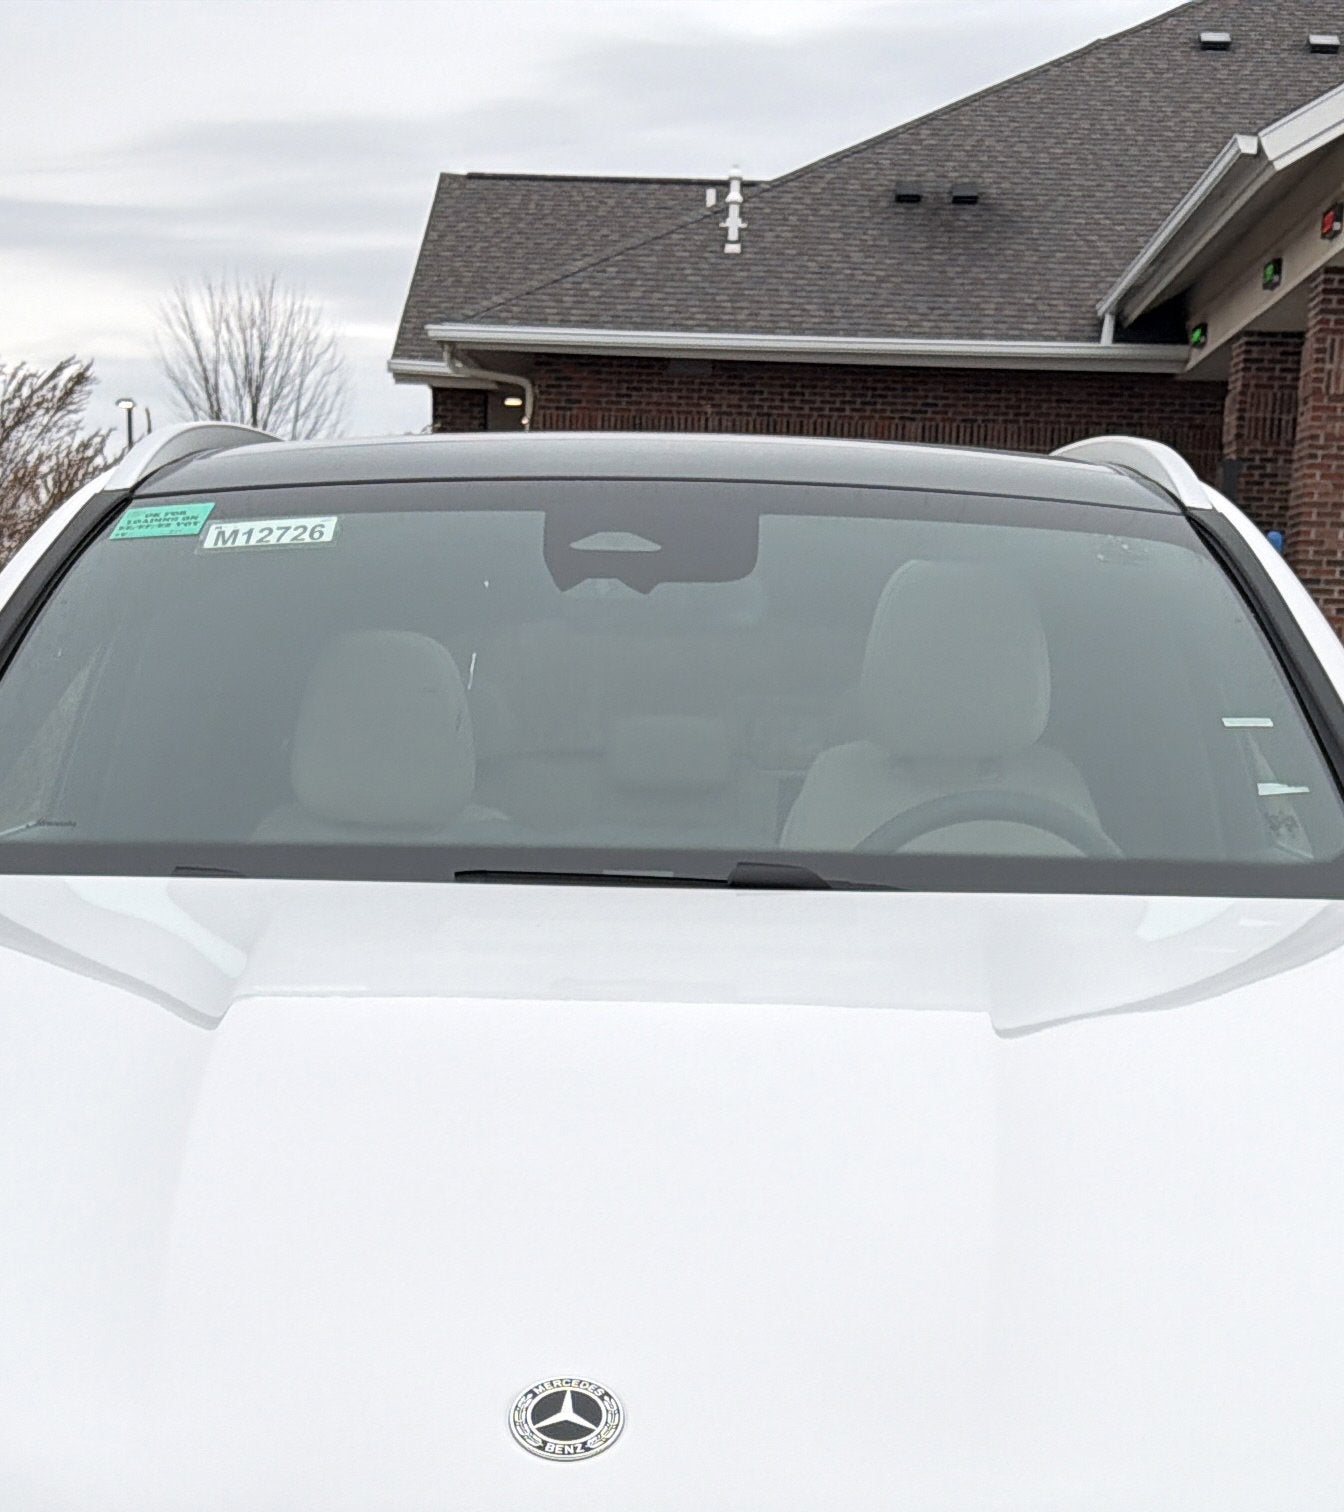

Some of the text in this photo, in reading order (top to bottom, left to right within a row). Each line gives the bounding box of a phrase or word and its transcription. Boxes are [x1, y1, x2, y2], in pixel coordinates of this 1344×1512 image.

[214, 524, 325, 546] M12726
[533, 1379, 605, 1396] MERCEDES
[545, 1443, 585, 1454] BENZ
